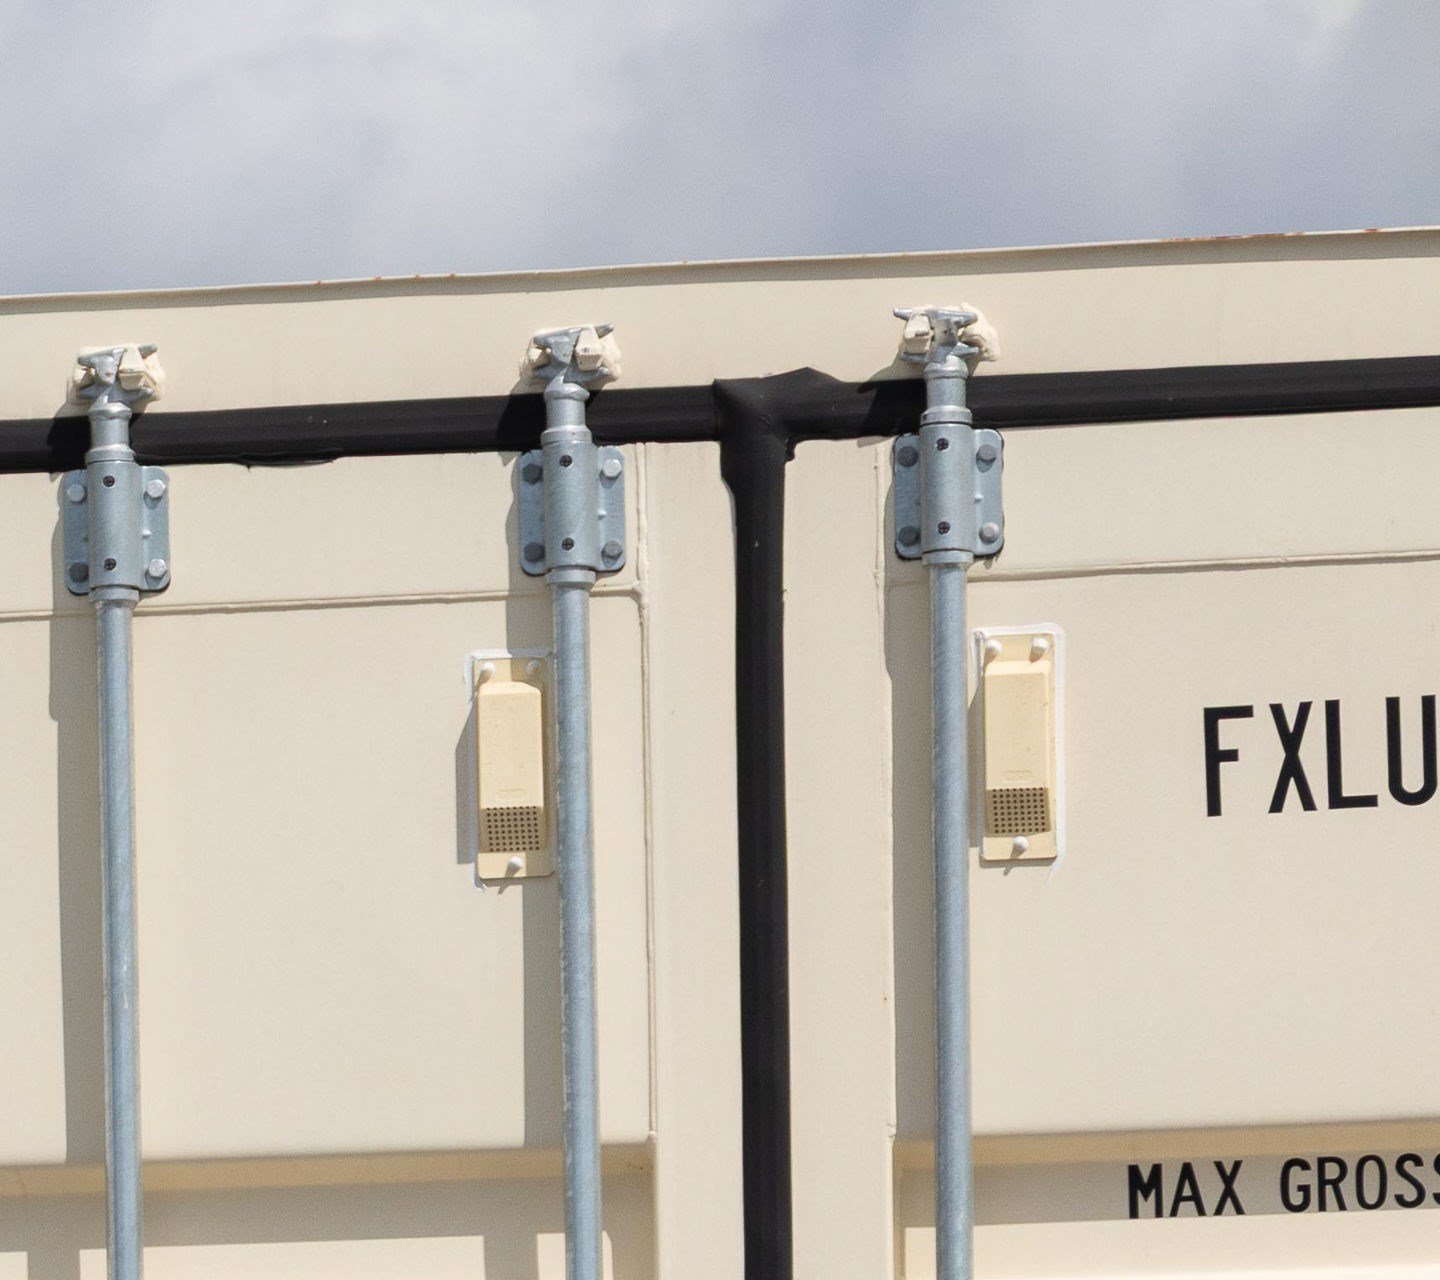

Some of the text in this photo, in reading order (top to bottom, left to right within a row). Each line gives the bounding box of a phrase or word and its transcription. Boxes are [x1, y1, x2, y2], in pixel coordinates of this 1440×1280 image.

[1203, 694, 1438, 817] FXLU
[1127, 1153, 1440, 1219] MAX GROS
